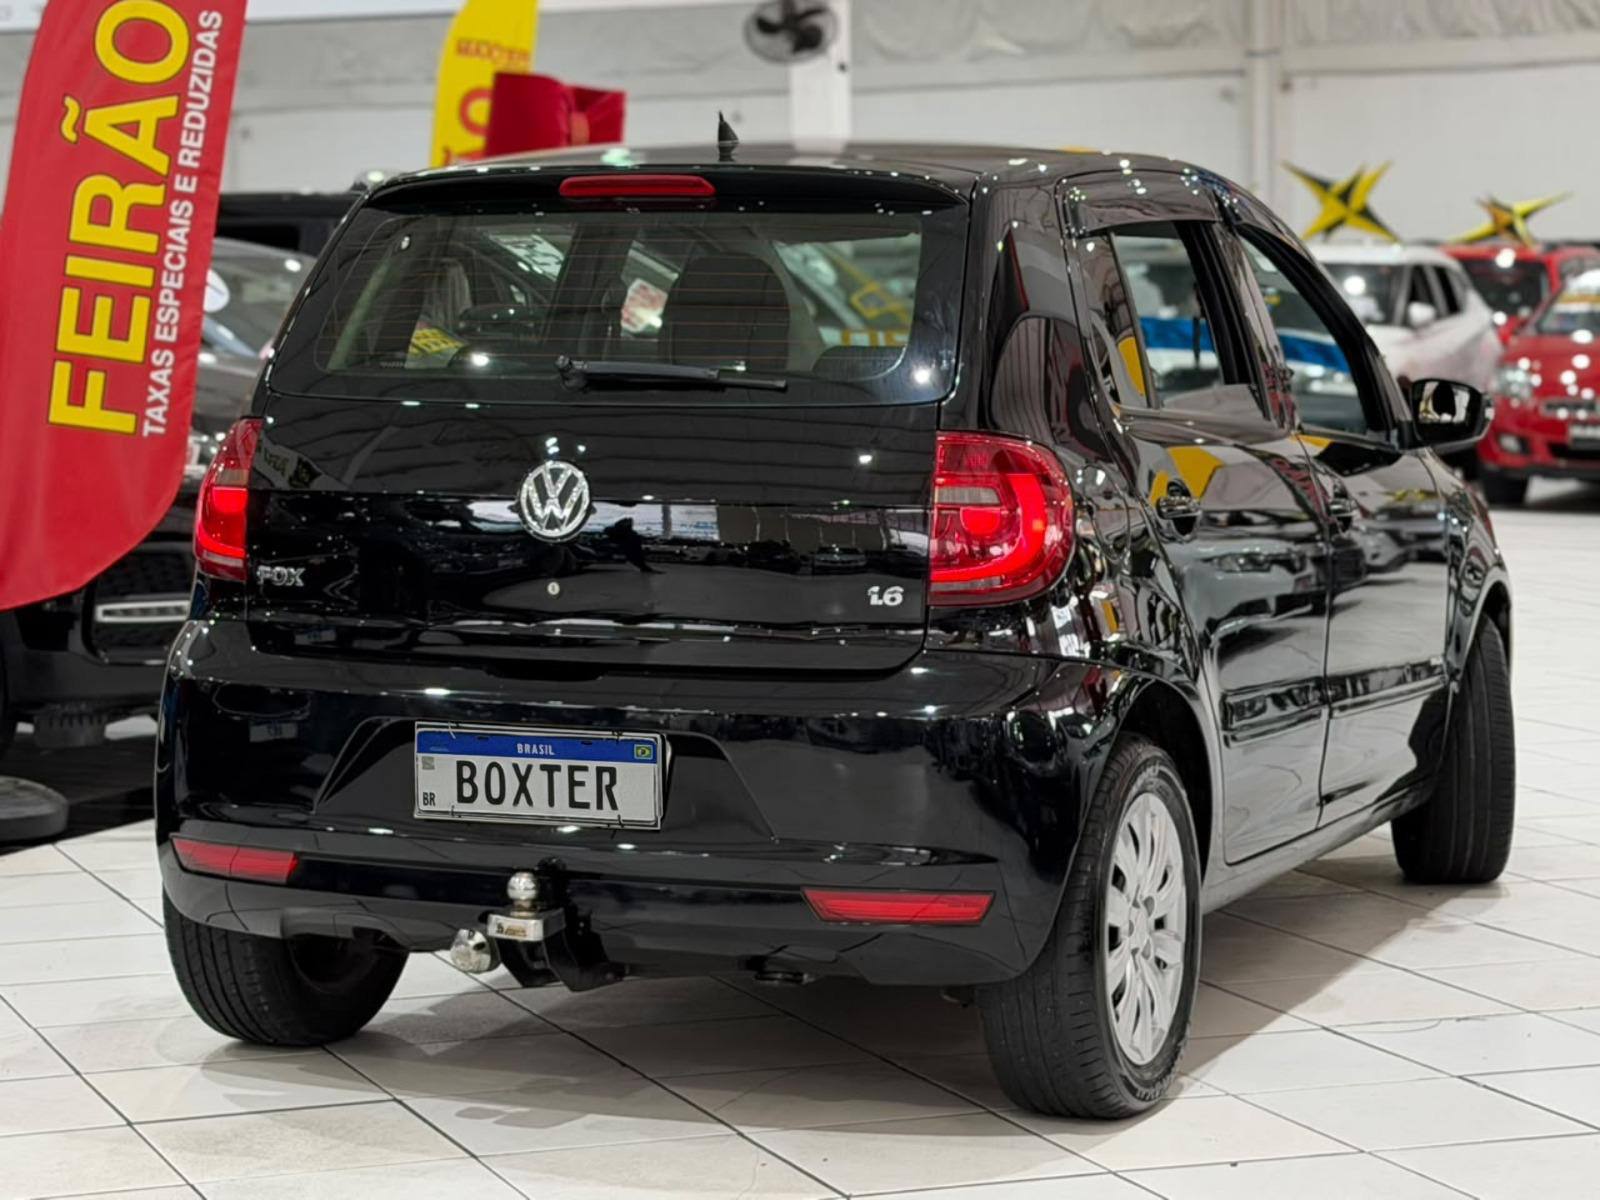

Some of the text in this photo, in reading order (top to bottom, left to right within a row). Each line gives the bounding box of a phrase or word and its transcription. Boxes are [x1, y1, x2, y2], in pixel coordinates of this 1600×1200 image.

[47, 0, 190, 433] FEIRÃO
[142, 10, 223, 437] TAXAS ESPECIAIS E REDUZIDAS
[257, 565, 305, 587] FOX
[867, 585, 905, 606] 1.6
[516, 743, 556, 756] BRASIL
[456, 760, 618, 810] BOXTER
[422, 791, 436, 806] BR
